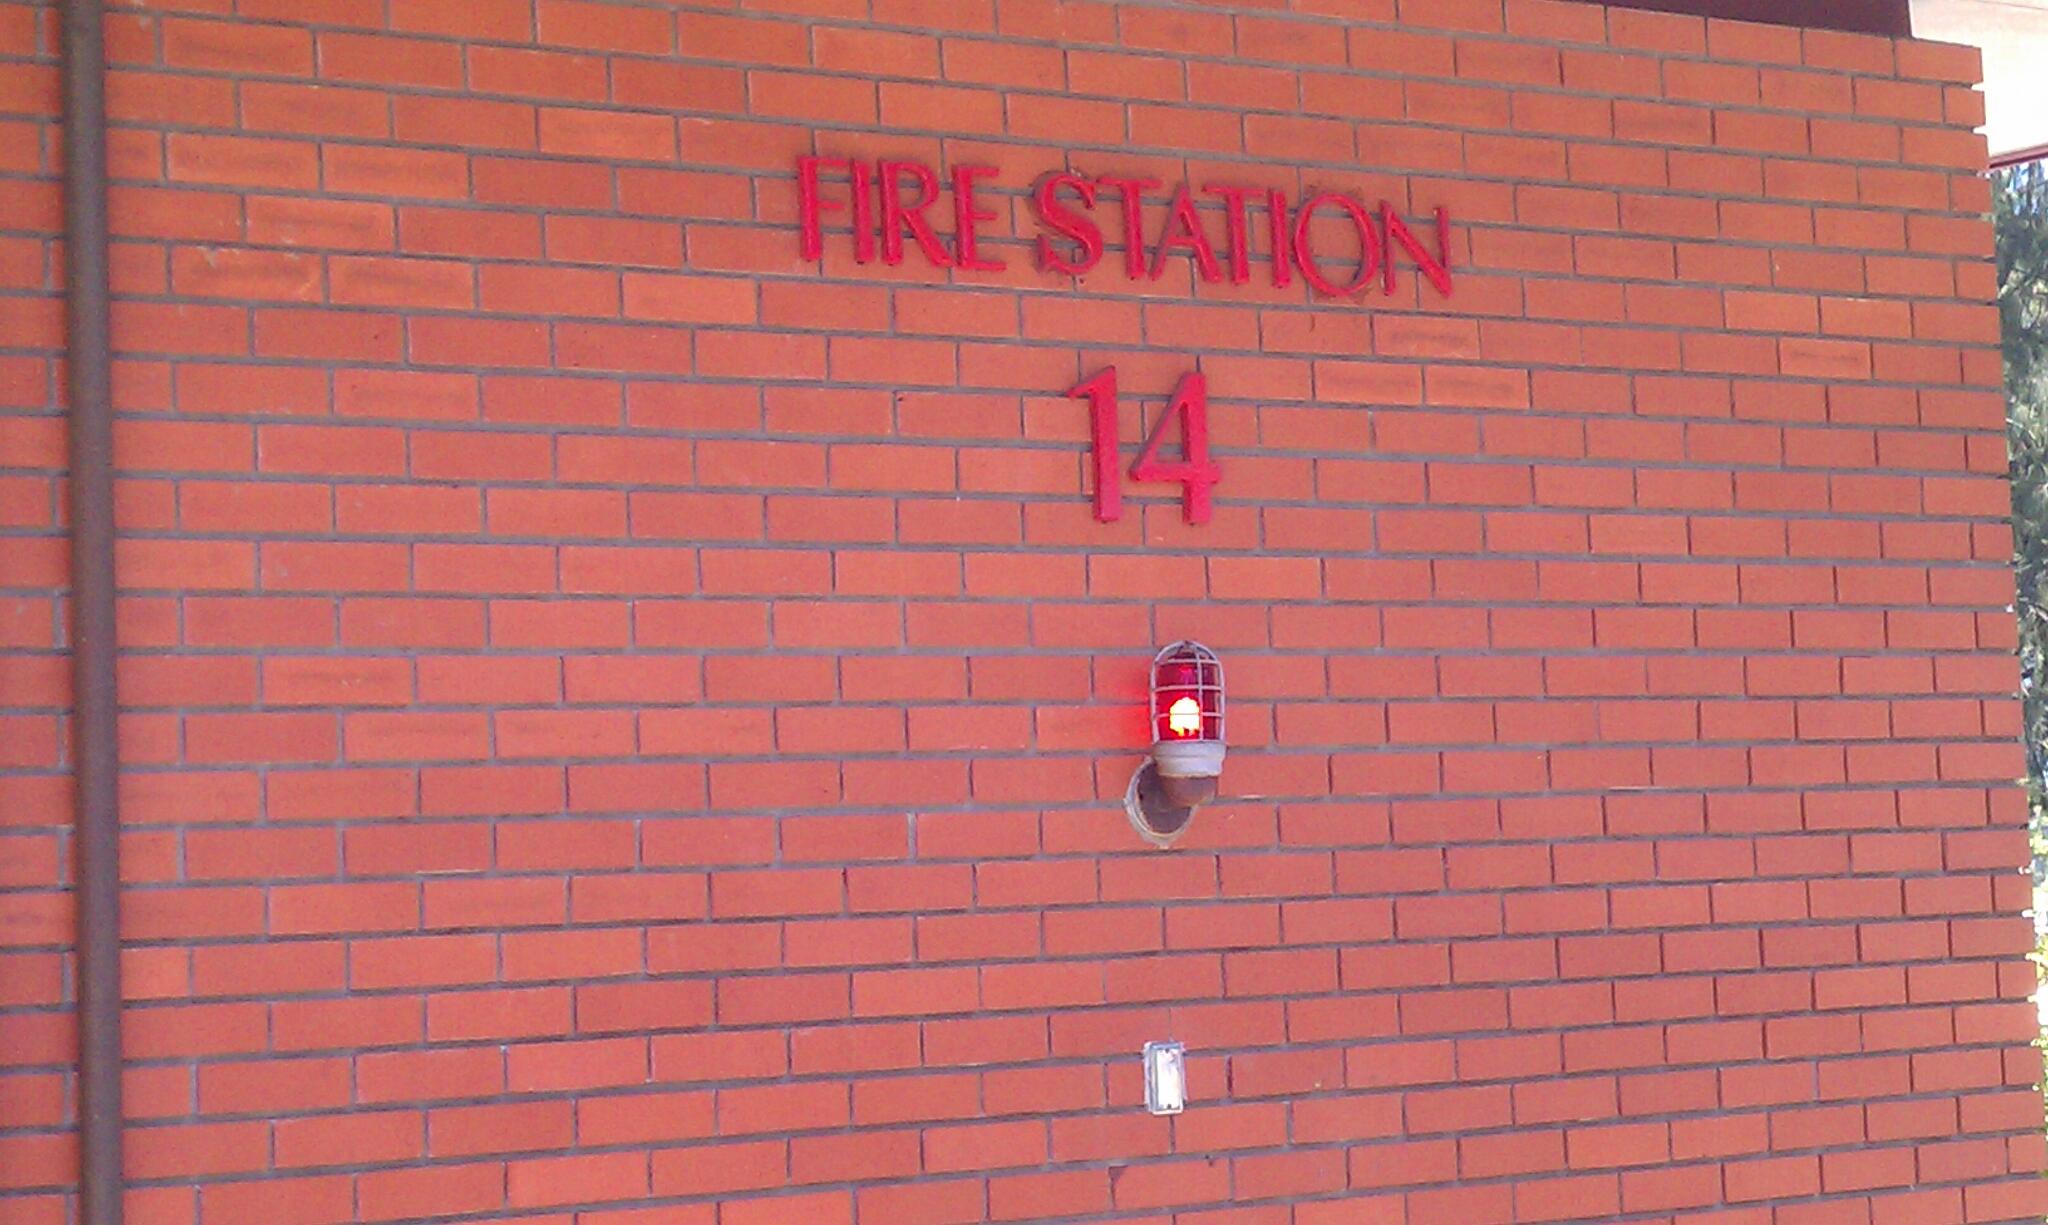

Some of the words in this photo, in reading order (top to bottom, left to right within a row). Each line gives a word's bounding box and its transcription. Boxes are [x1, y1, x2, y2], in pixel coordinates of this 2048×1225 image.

[797, 155, 1006, 272] FIRE
[1034, 171, 1451, 298] STATION
[1066, 365, 1221, 524] 14
